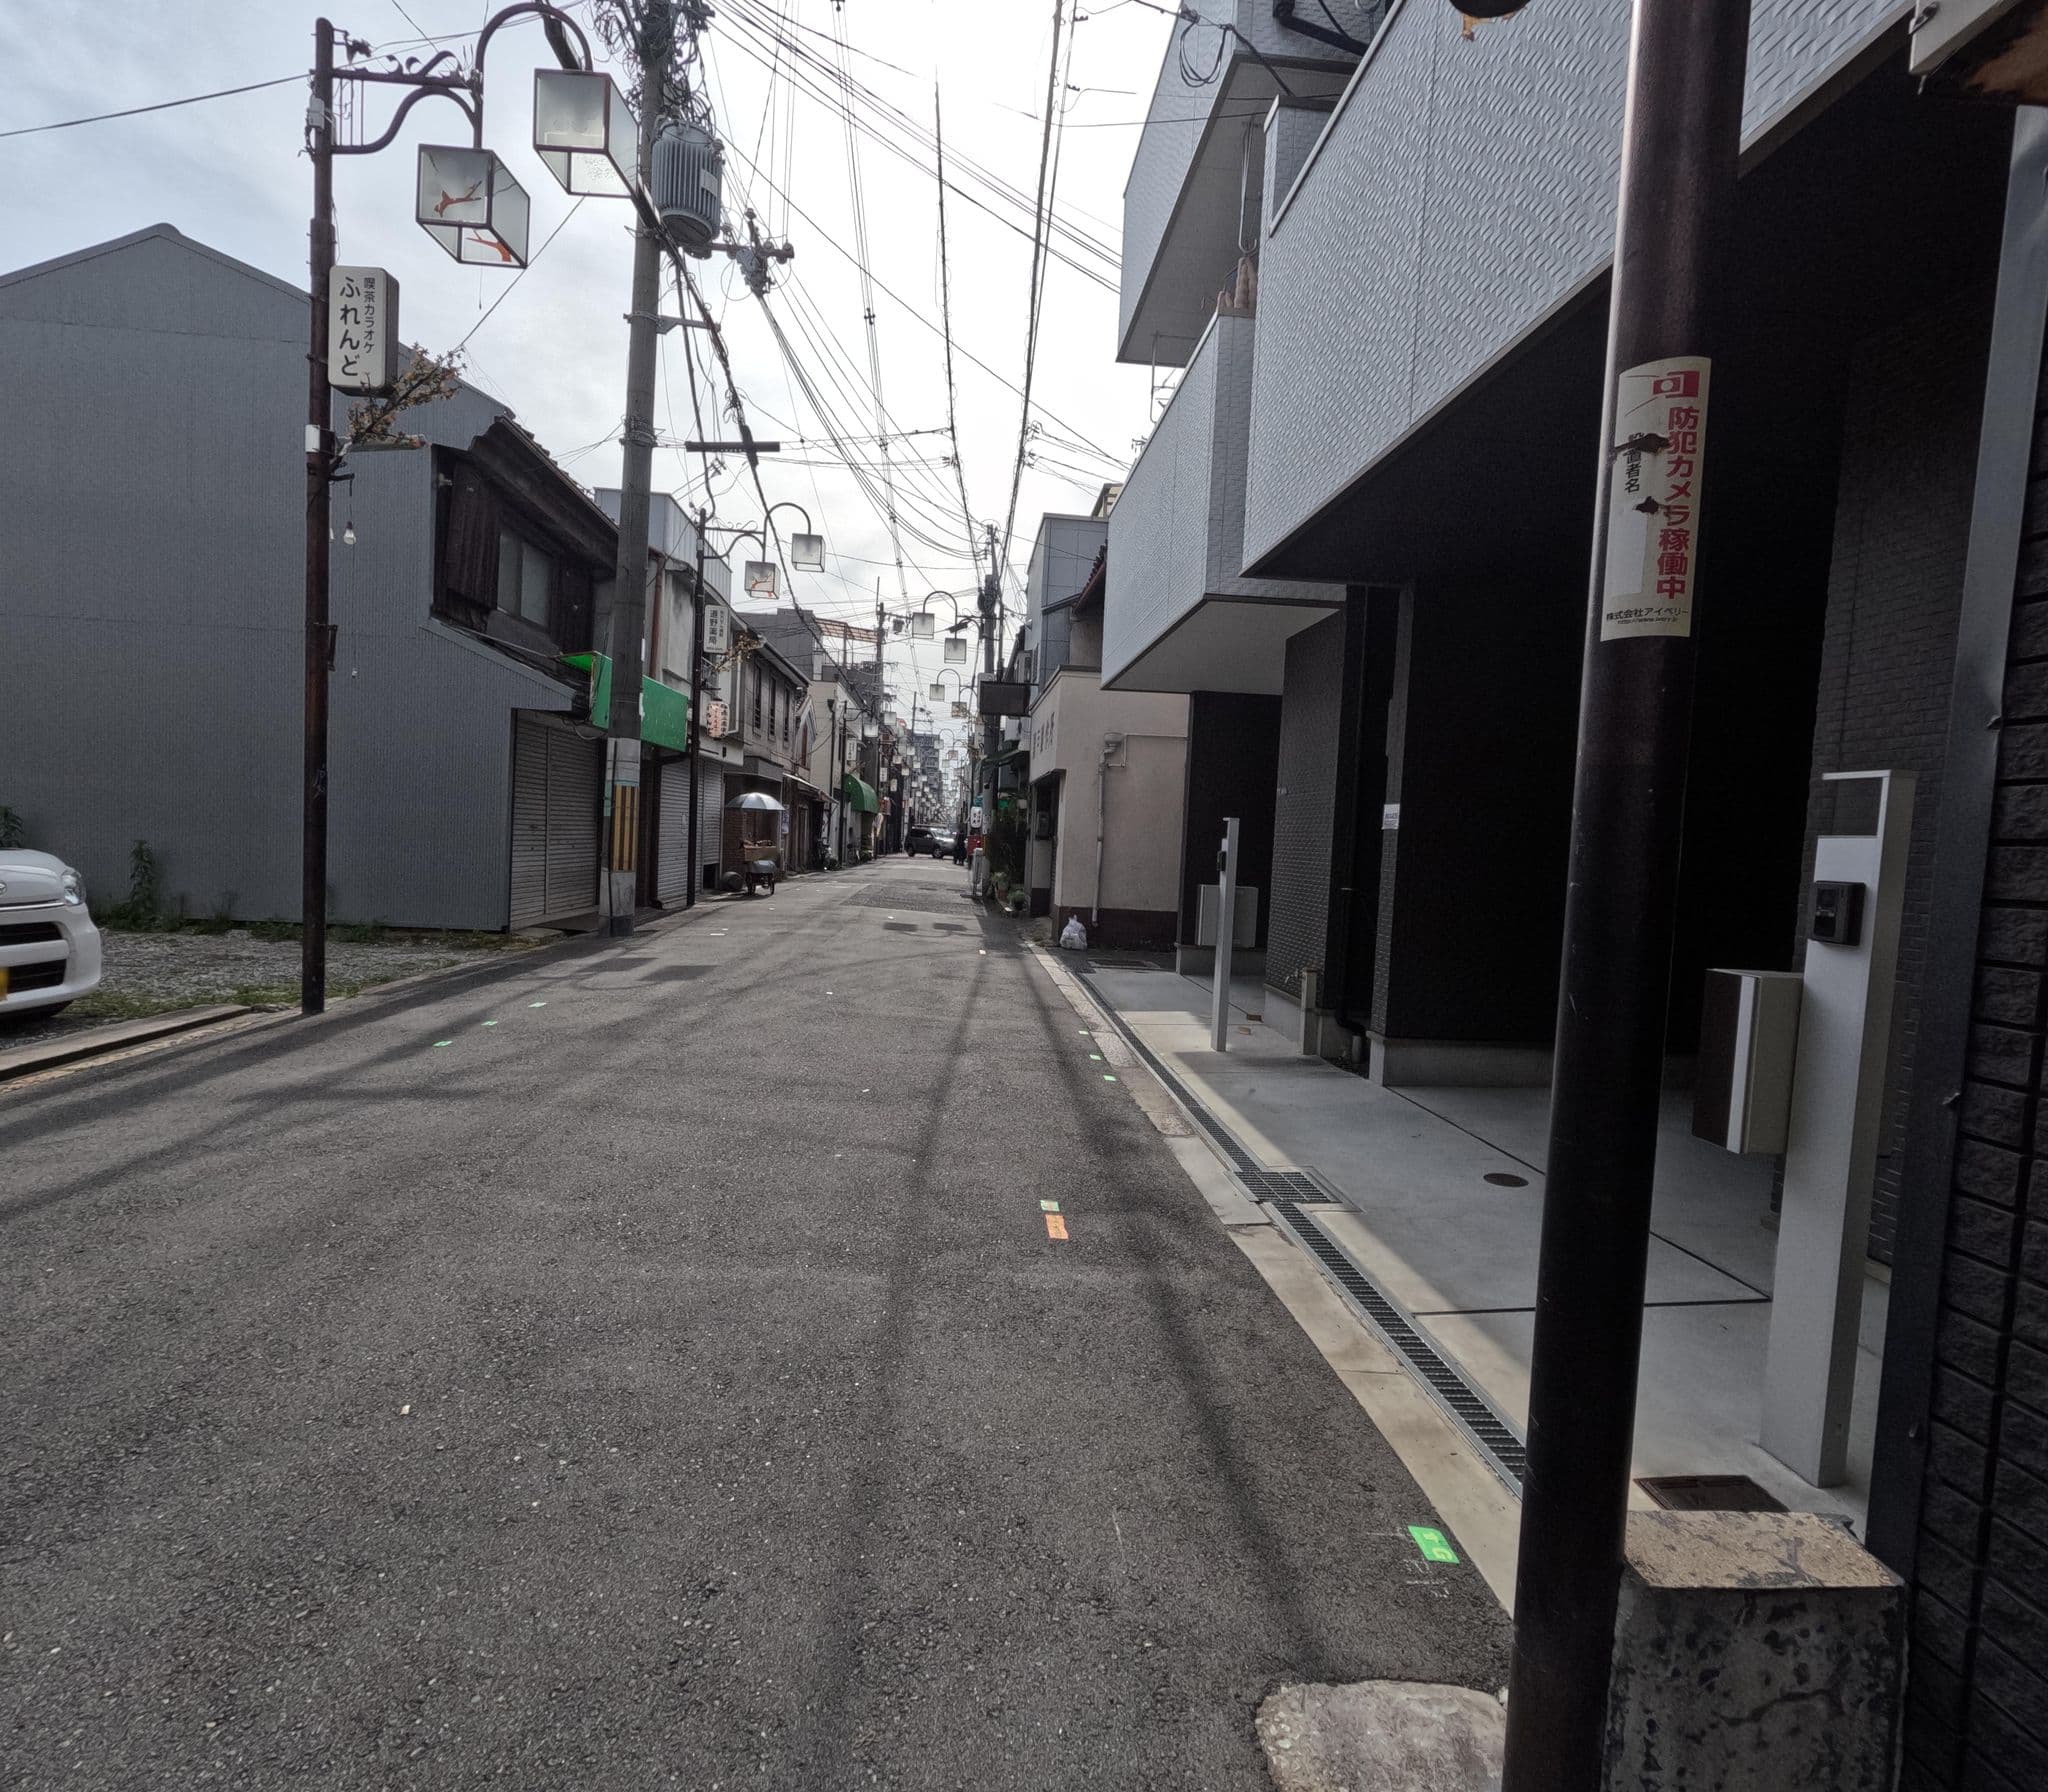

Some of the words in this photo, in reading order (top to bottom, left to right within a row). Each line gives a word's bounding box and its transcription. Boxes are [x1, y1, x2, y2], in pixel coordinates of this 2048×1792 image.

[339, 276, 361, 376] ふれんど
[363, 277, 376, 354] 喫茶カラオケ
[1656, 406, 1700, 600] 防犯カメラ稼働中
